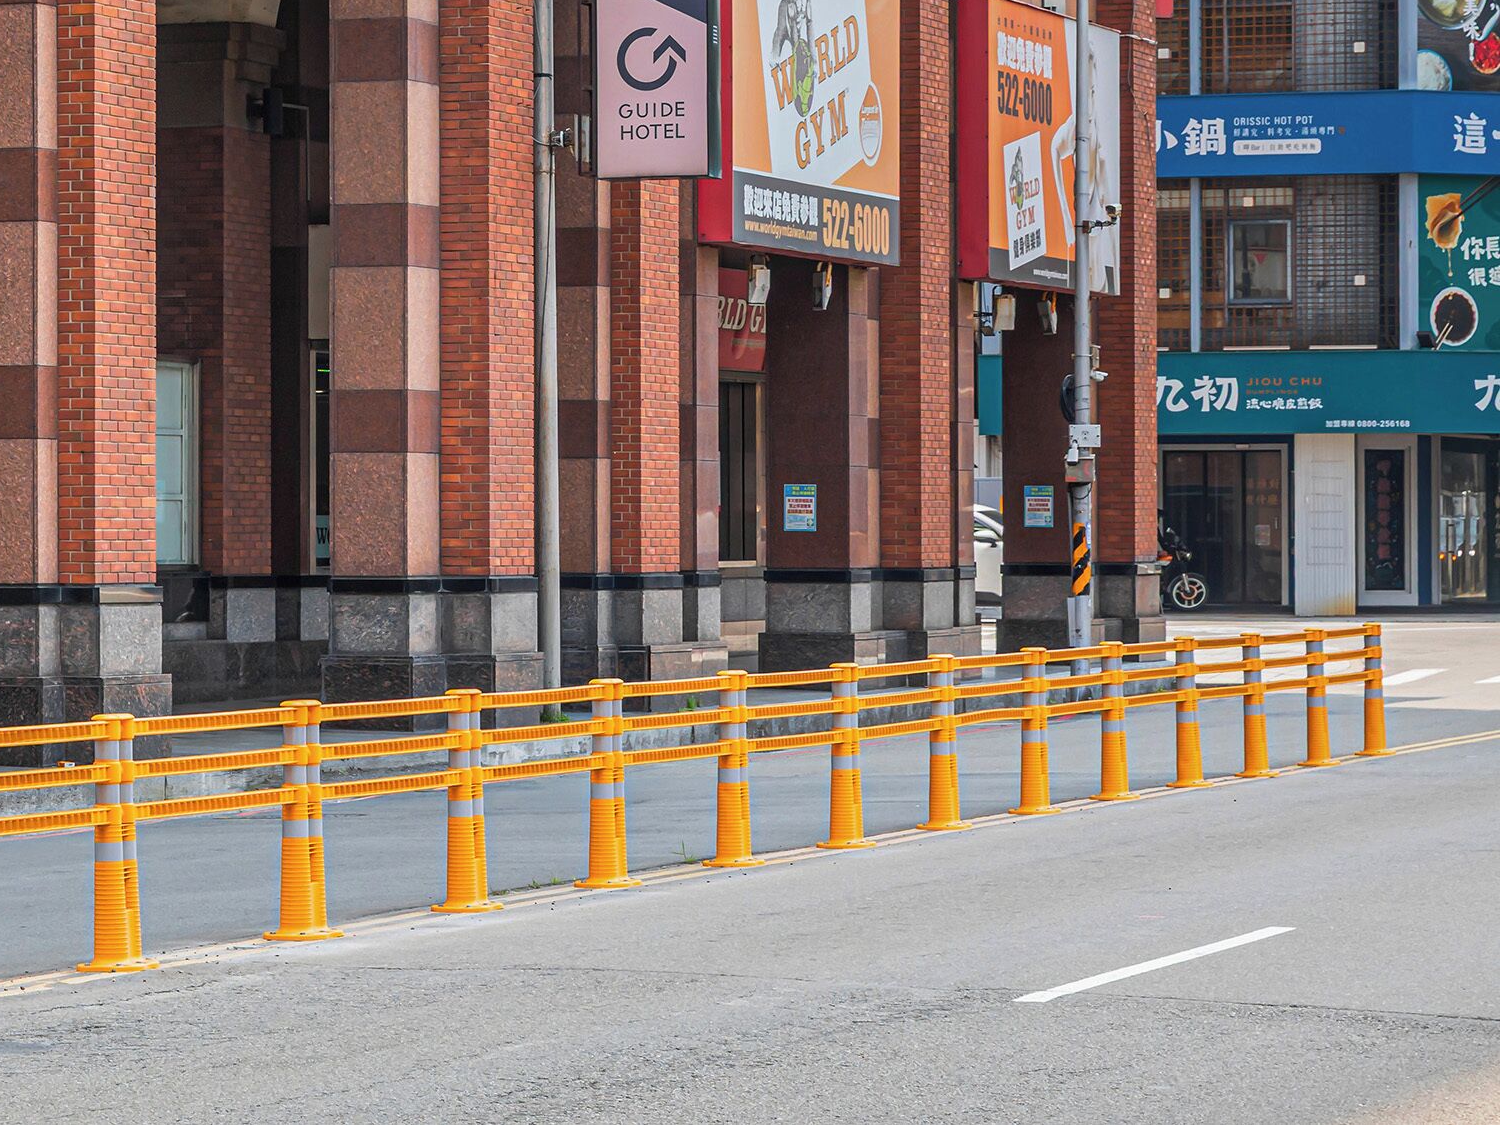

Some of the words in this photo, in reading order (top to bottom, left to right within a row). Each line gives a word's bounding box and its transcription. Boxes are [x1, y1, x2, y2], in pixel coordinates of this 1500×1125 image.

[997, 70, 1053, 126] 522-6000
[619, 101, 685, 119] GUIDE
[1233, 117, 1271, 126] ORISSIC
[1274, 116, 1292, 125] HOT
[1295, 115, 1313, 124] POT
[620, 123, 685, 141] HOTEL
[795, 91, 849, 169] GYM
[822, 197, 890, 256] 522-6000
[1016, 205, 1036, 231] GYM
[1246, 377, 1282, 386] JIOU
[1289, 377, 1322, 386] CHU
[1156, 375, 1239, 412] 九初
[1356, 419, 1410, 428] 0800-256168
